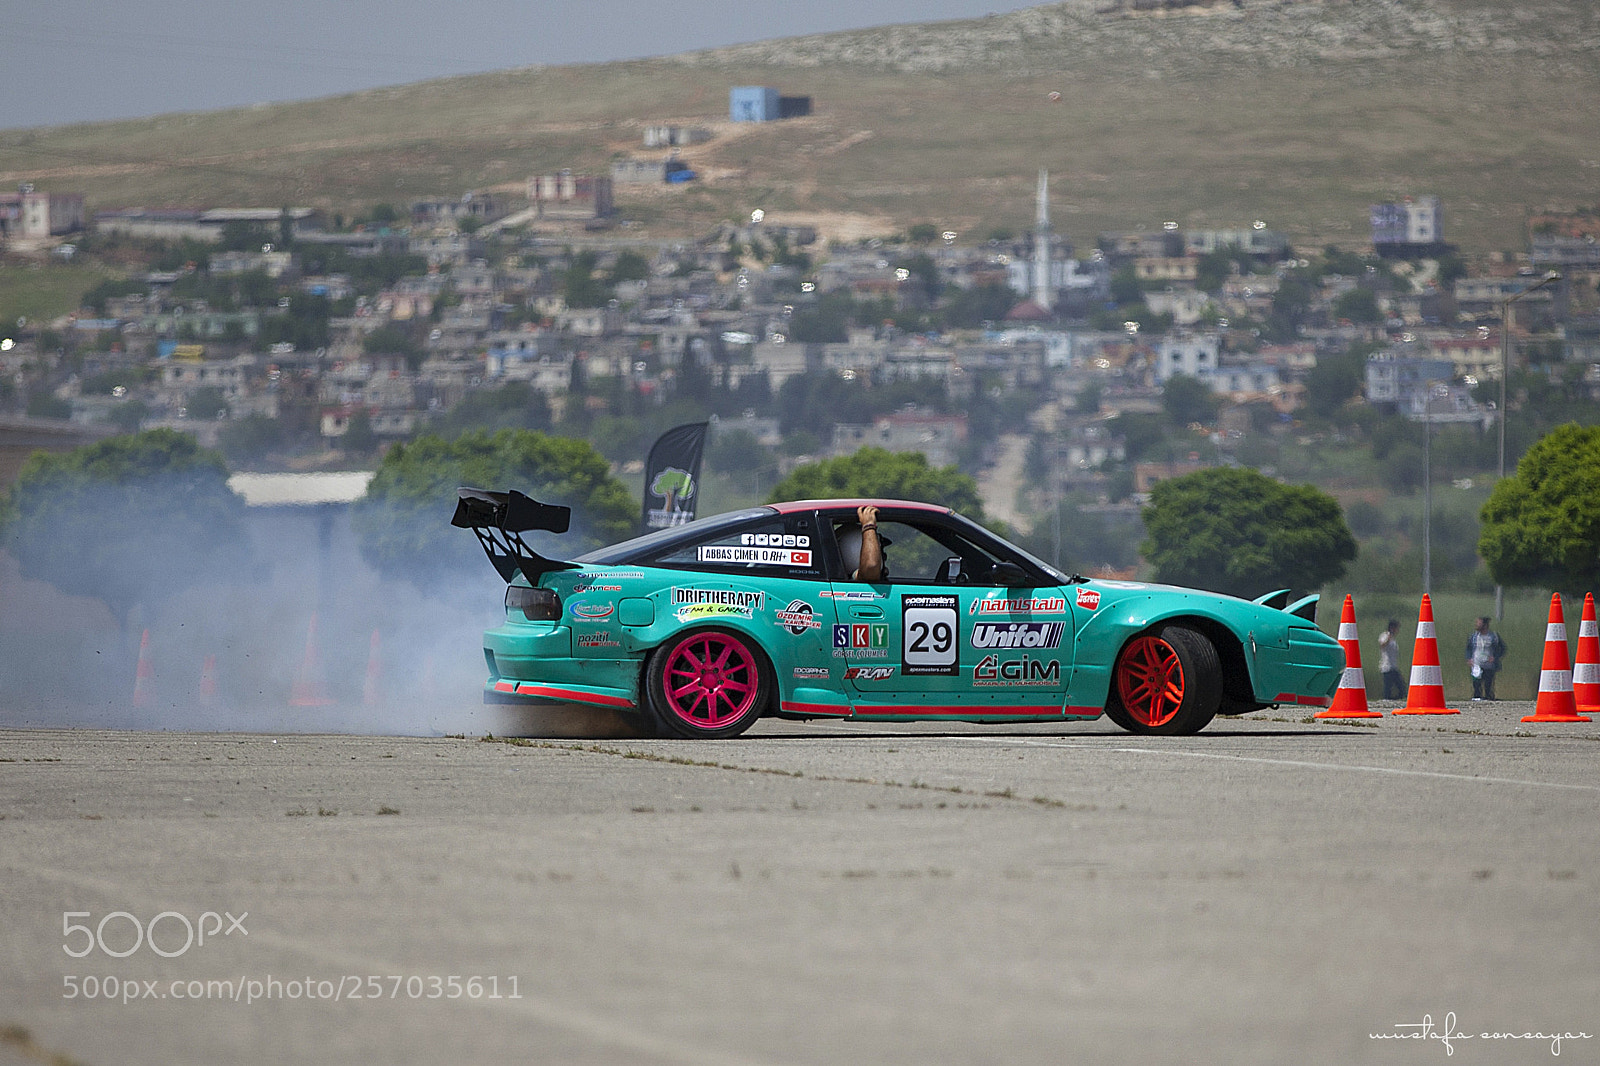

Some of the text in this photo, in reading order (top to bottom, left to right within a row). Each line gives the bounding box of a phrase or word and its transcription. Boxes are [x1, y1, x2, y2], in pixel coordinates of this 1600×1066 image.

[705, 549, 732, 559] ABBAS
[734, 548, 759, 561] ÇİMEN
[770, 551, 787, 562] RH+
[717, 606, 752, 614] GARAGE
[980, 597, 1065, 611] namistain
[777, 611, 813, 621] ÖZDEMİR
[577, 631, 609, 647] pozitif
[836, 627, 885, 645] SKY
[908, 621, 953, 653] 29
[972, 624, 1050, 648] Unifol
